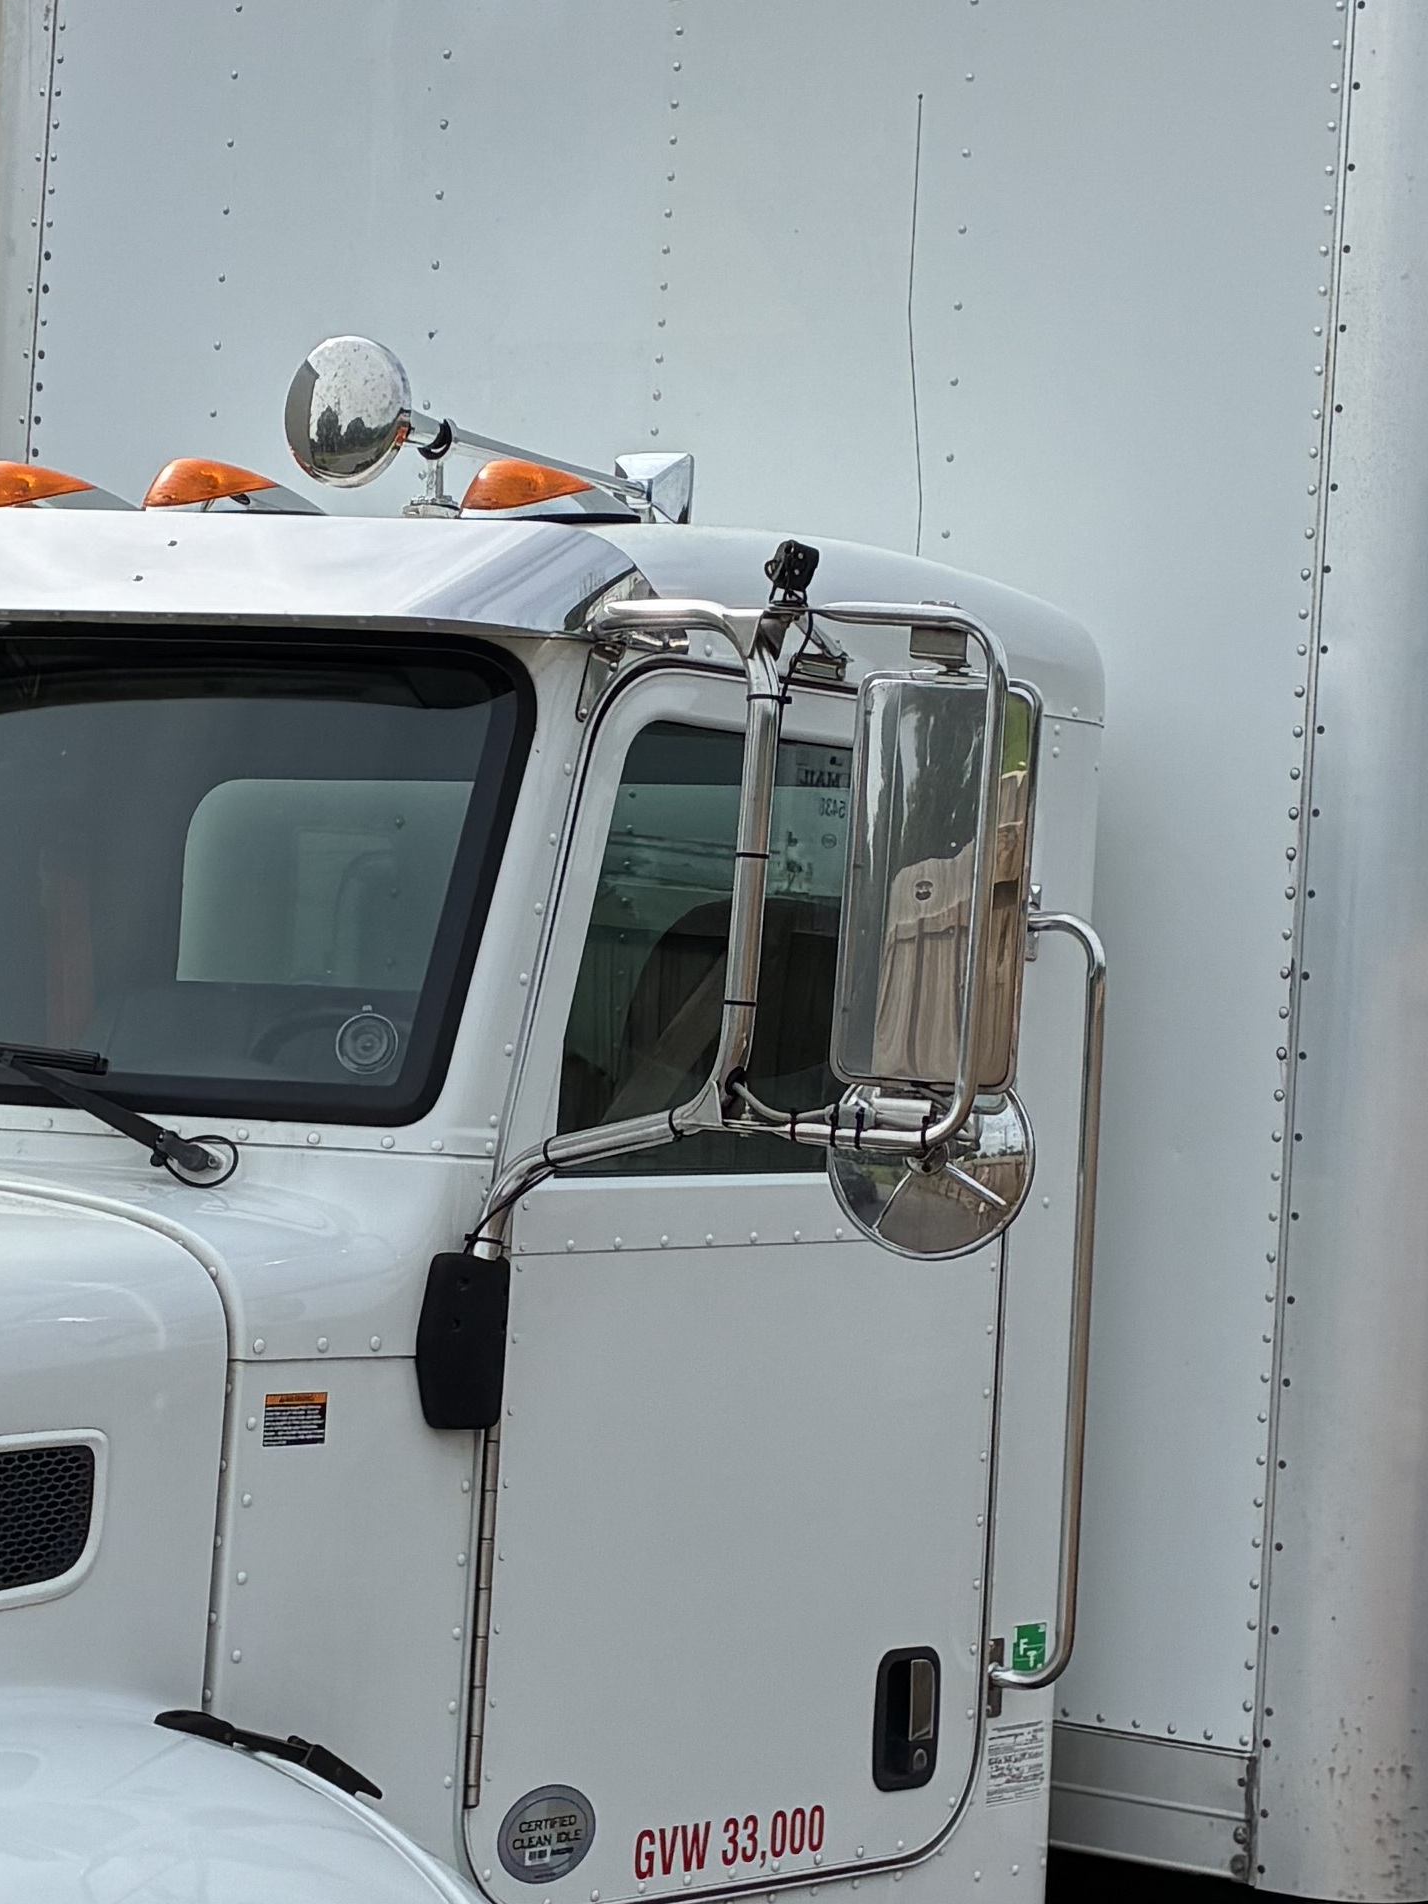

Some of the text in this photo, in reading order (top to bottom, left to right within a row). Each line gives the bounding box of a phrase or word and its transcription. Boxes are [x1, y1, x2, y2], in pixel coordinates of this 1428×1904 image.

[519, 1815, 577, 1833] CERTIFIED
[513, 1829, 582, 1850] CLEAN IDLE
[634, 1805, 825, 1880] GVW 33,000
